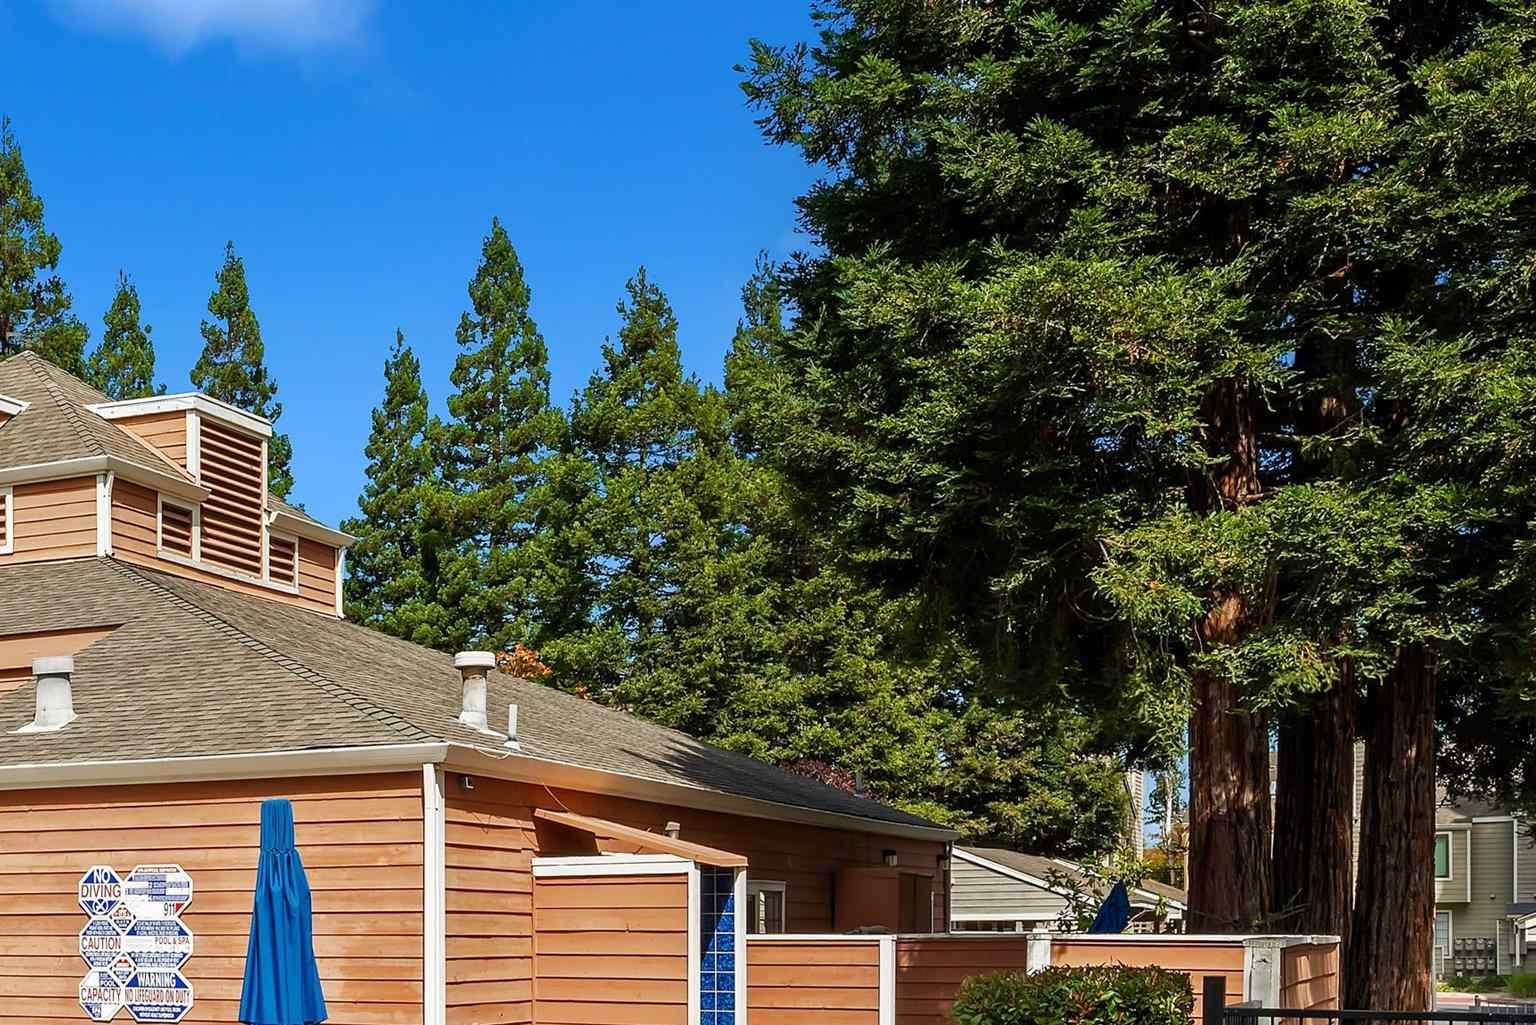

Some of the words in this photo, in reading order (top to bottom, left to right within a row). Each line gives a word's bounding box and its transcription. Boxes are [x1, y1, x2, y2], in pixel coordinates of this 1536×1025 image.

[94, 868, 110, 883] NO
[81, 884, 122, 898] DIVING
[164, 902, 176, 917] 911
[81, 936, 122, 950] CAUTION
[138, 972, 176, 987] WARNING
[80, 987, 122, 1002] CAPACITY
